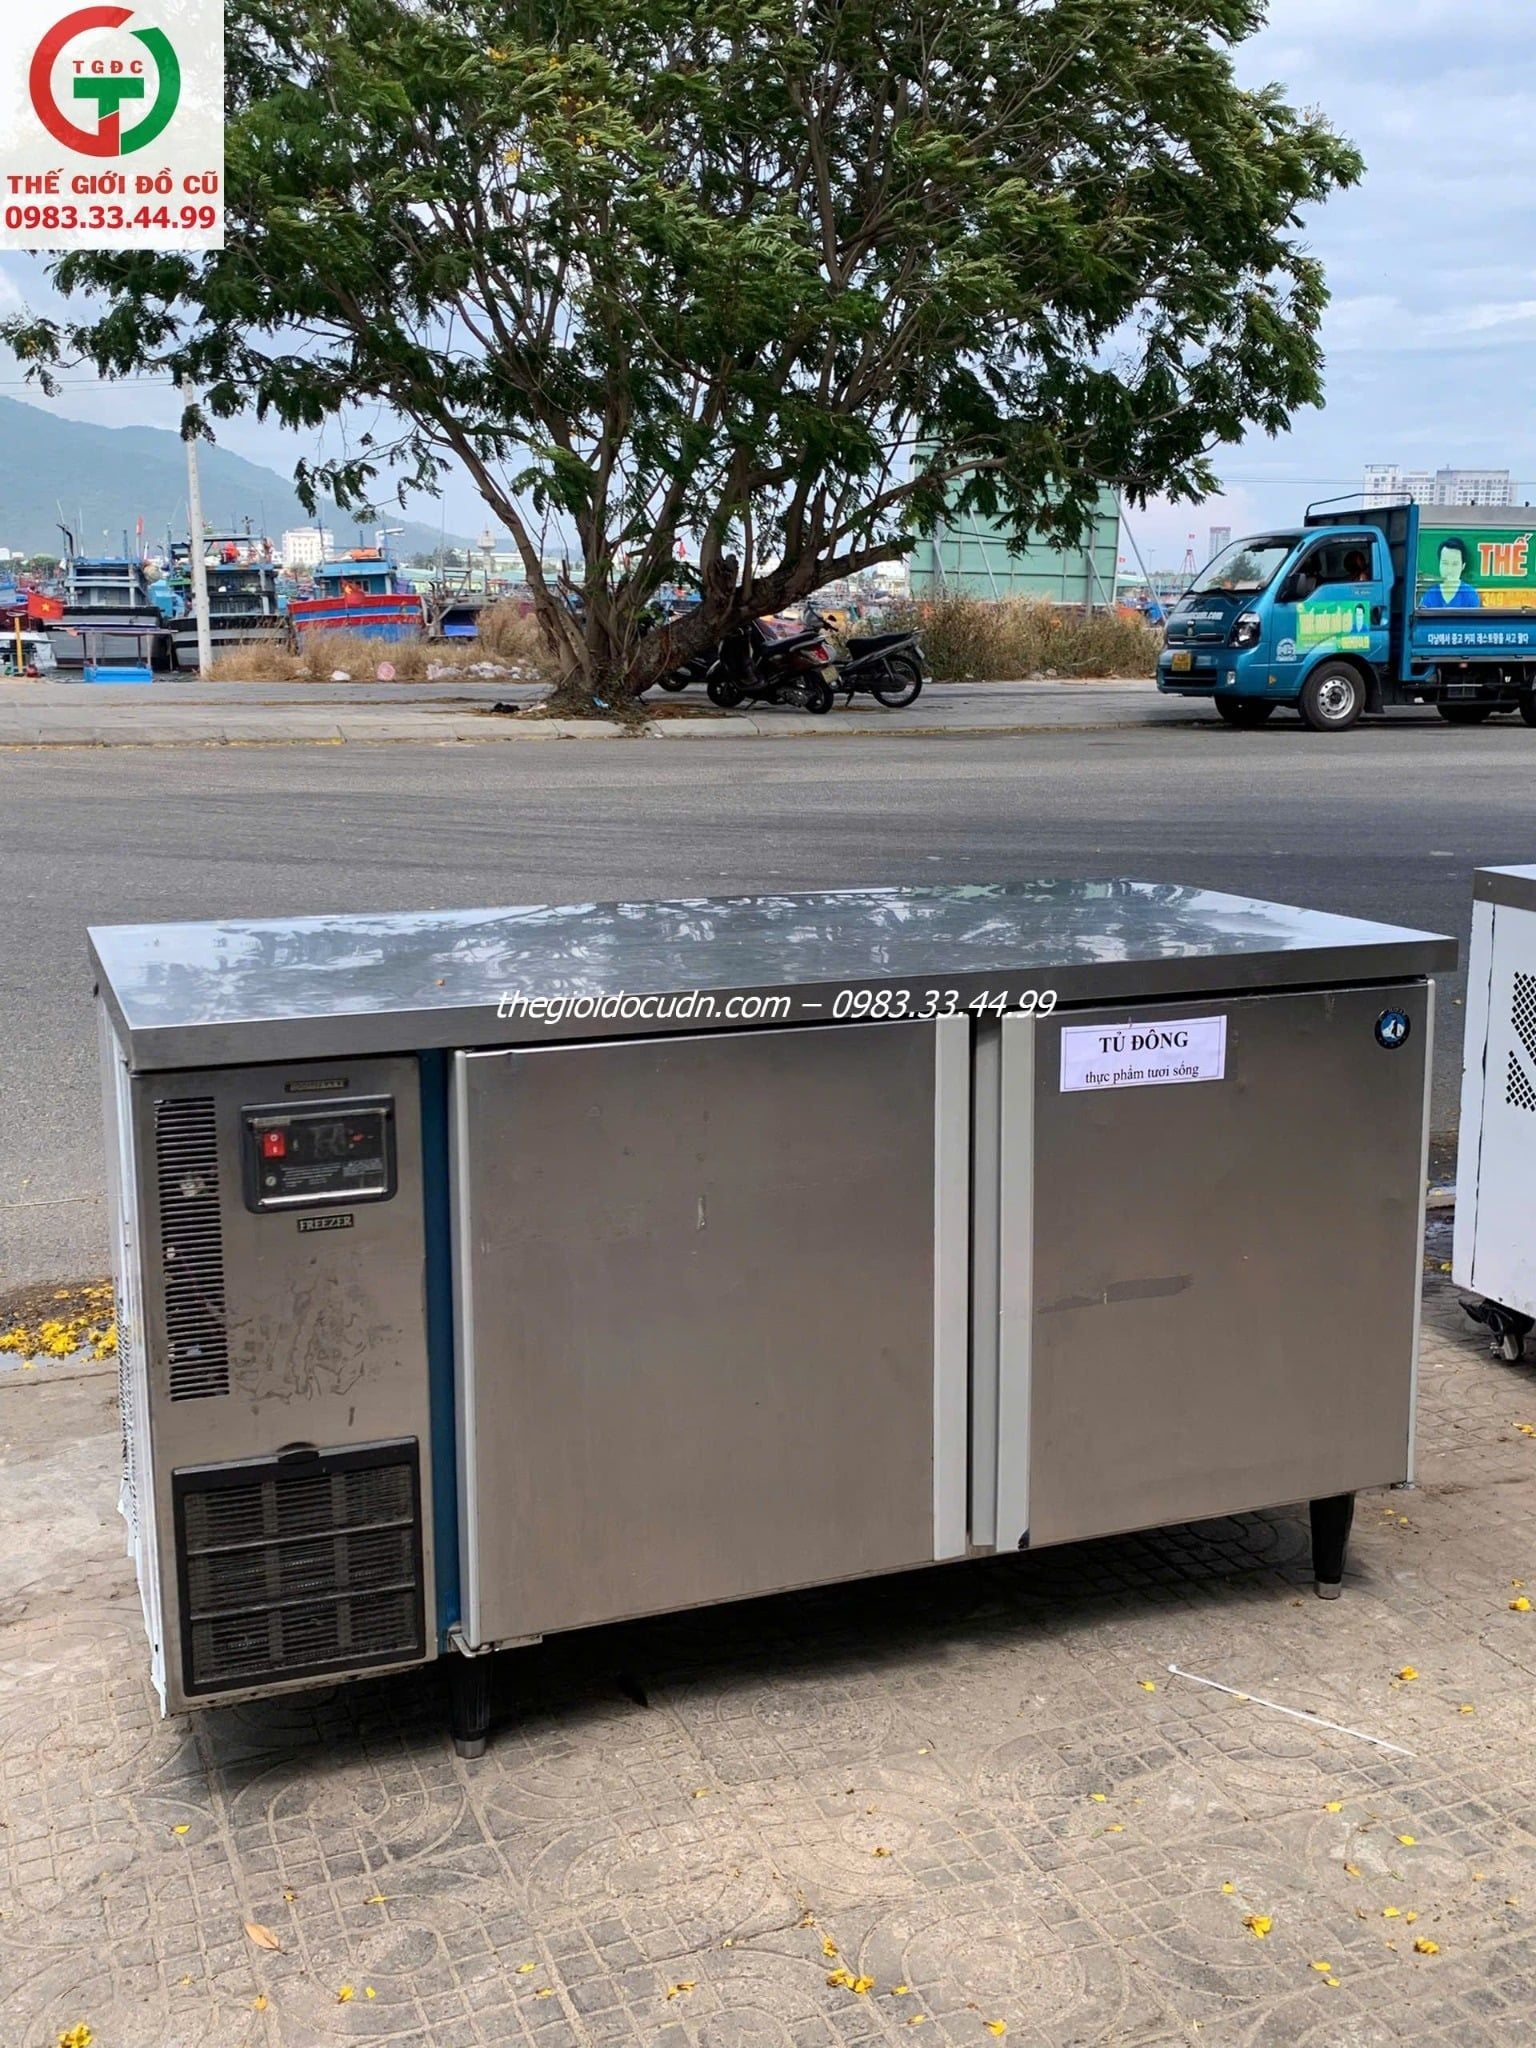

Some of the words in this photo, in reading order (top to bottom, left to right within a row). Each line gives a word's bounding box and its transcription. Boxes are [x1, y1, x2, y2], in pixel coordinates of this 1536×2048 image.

[1477, 533, 1533, 577] THẾ
[1099, 1031, 1125, 1053] TỦ
[1132, 1029, 1188, 1051] ĐÔNG
[1085, 1071, 1110, 1085] thực
[1113, 1064, 1144, 1084] phẩm
[1147, 1065, 1170, 1078] tươi
[1173, 1060, 1199, 1077] sống
[299, 1216, 352, 1232] FREEZER
